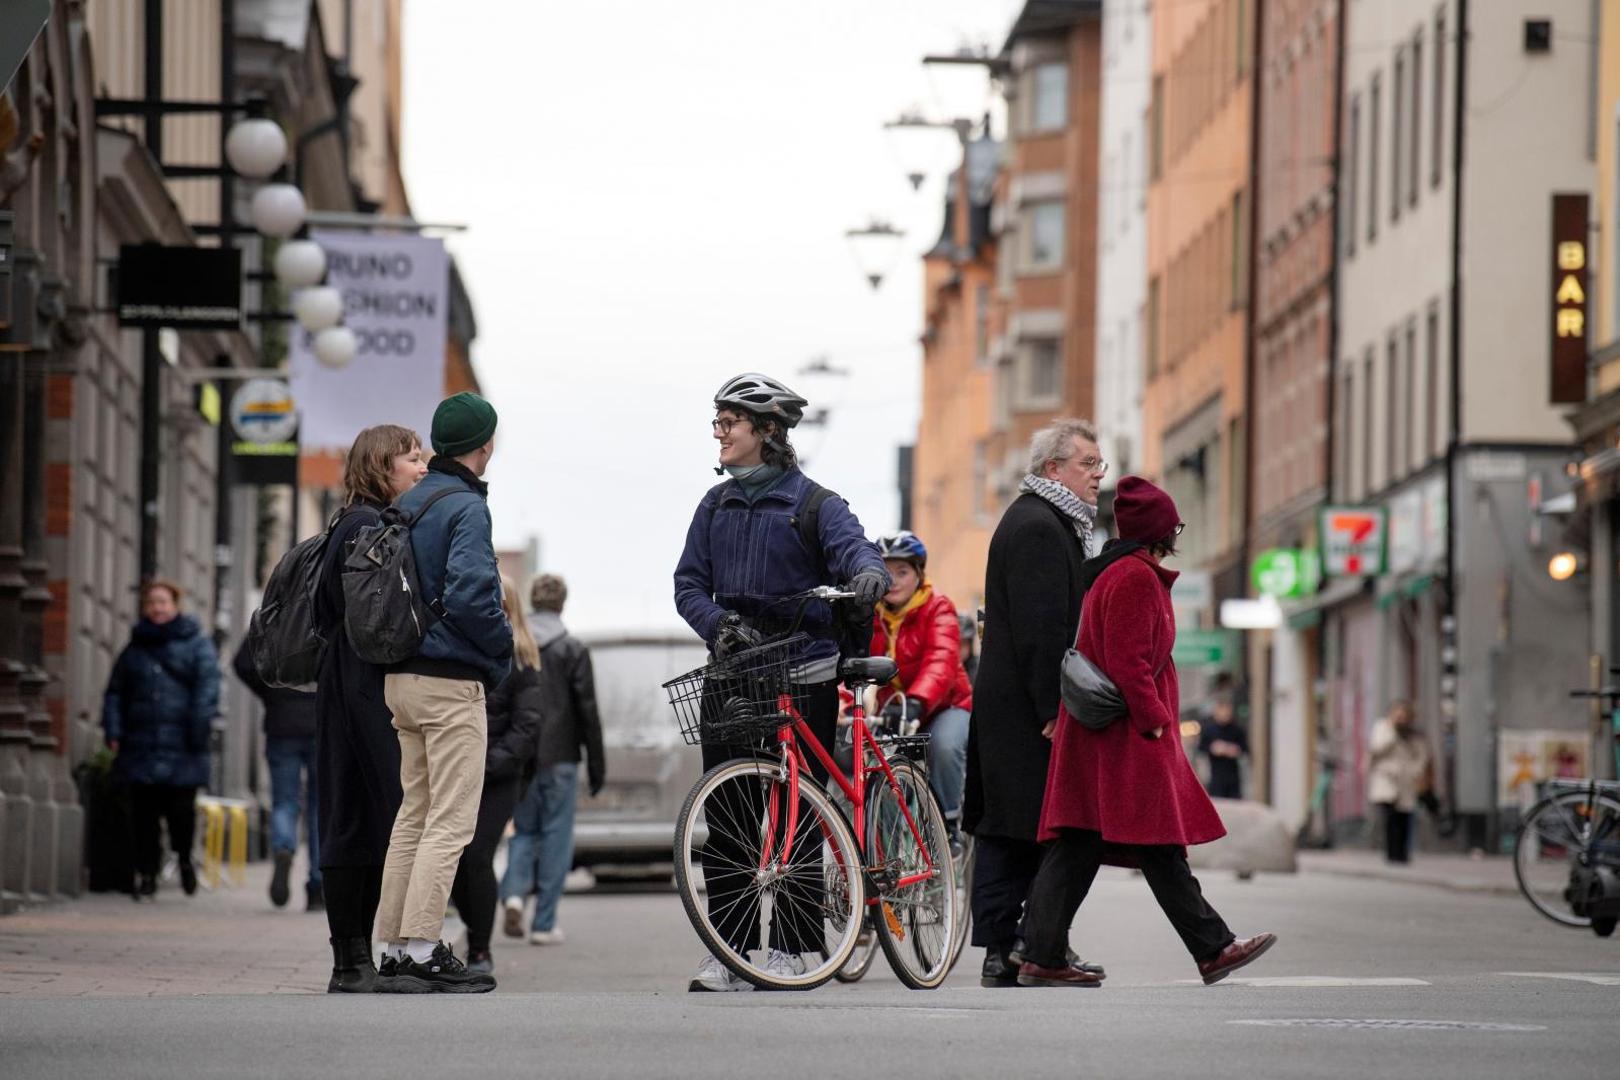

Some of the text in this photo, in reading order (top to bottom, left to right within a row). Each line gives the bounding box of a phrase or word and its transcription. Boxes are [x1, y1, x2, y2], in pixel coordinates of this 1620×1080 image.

[328, 250, 414, 279] RUNO
[1557, 240, 1585, 338] BAR
[342, 289, 437, 319] SHION
[354, 327, 416, 356] OOD
